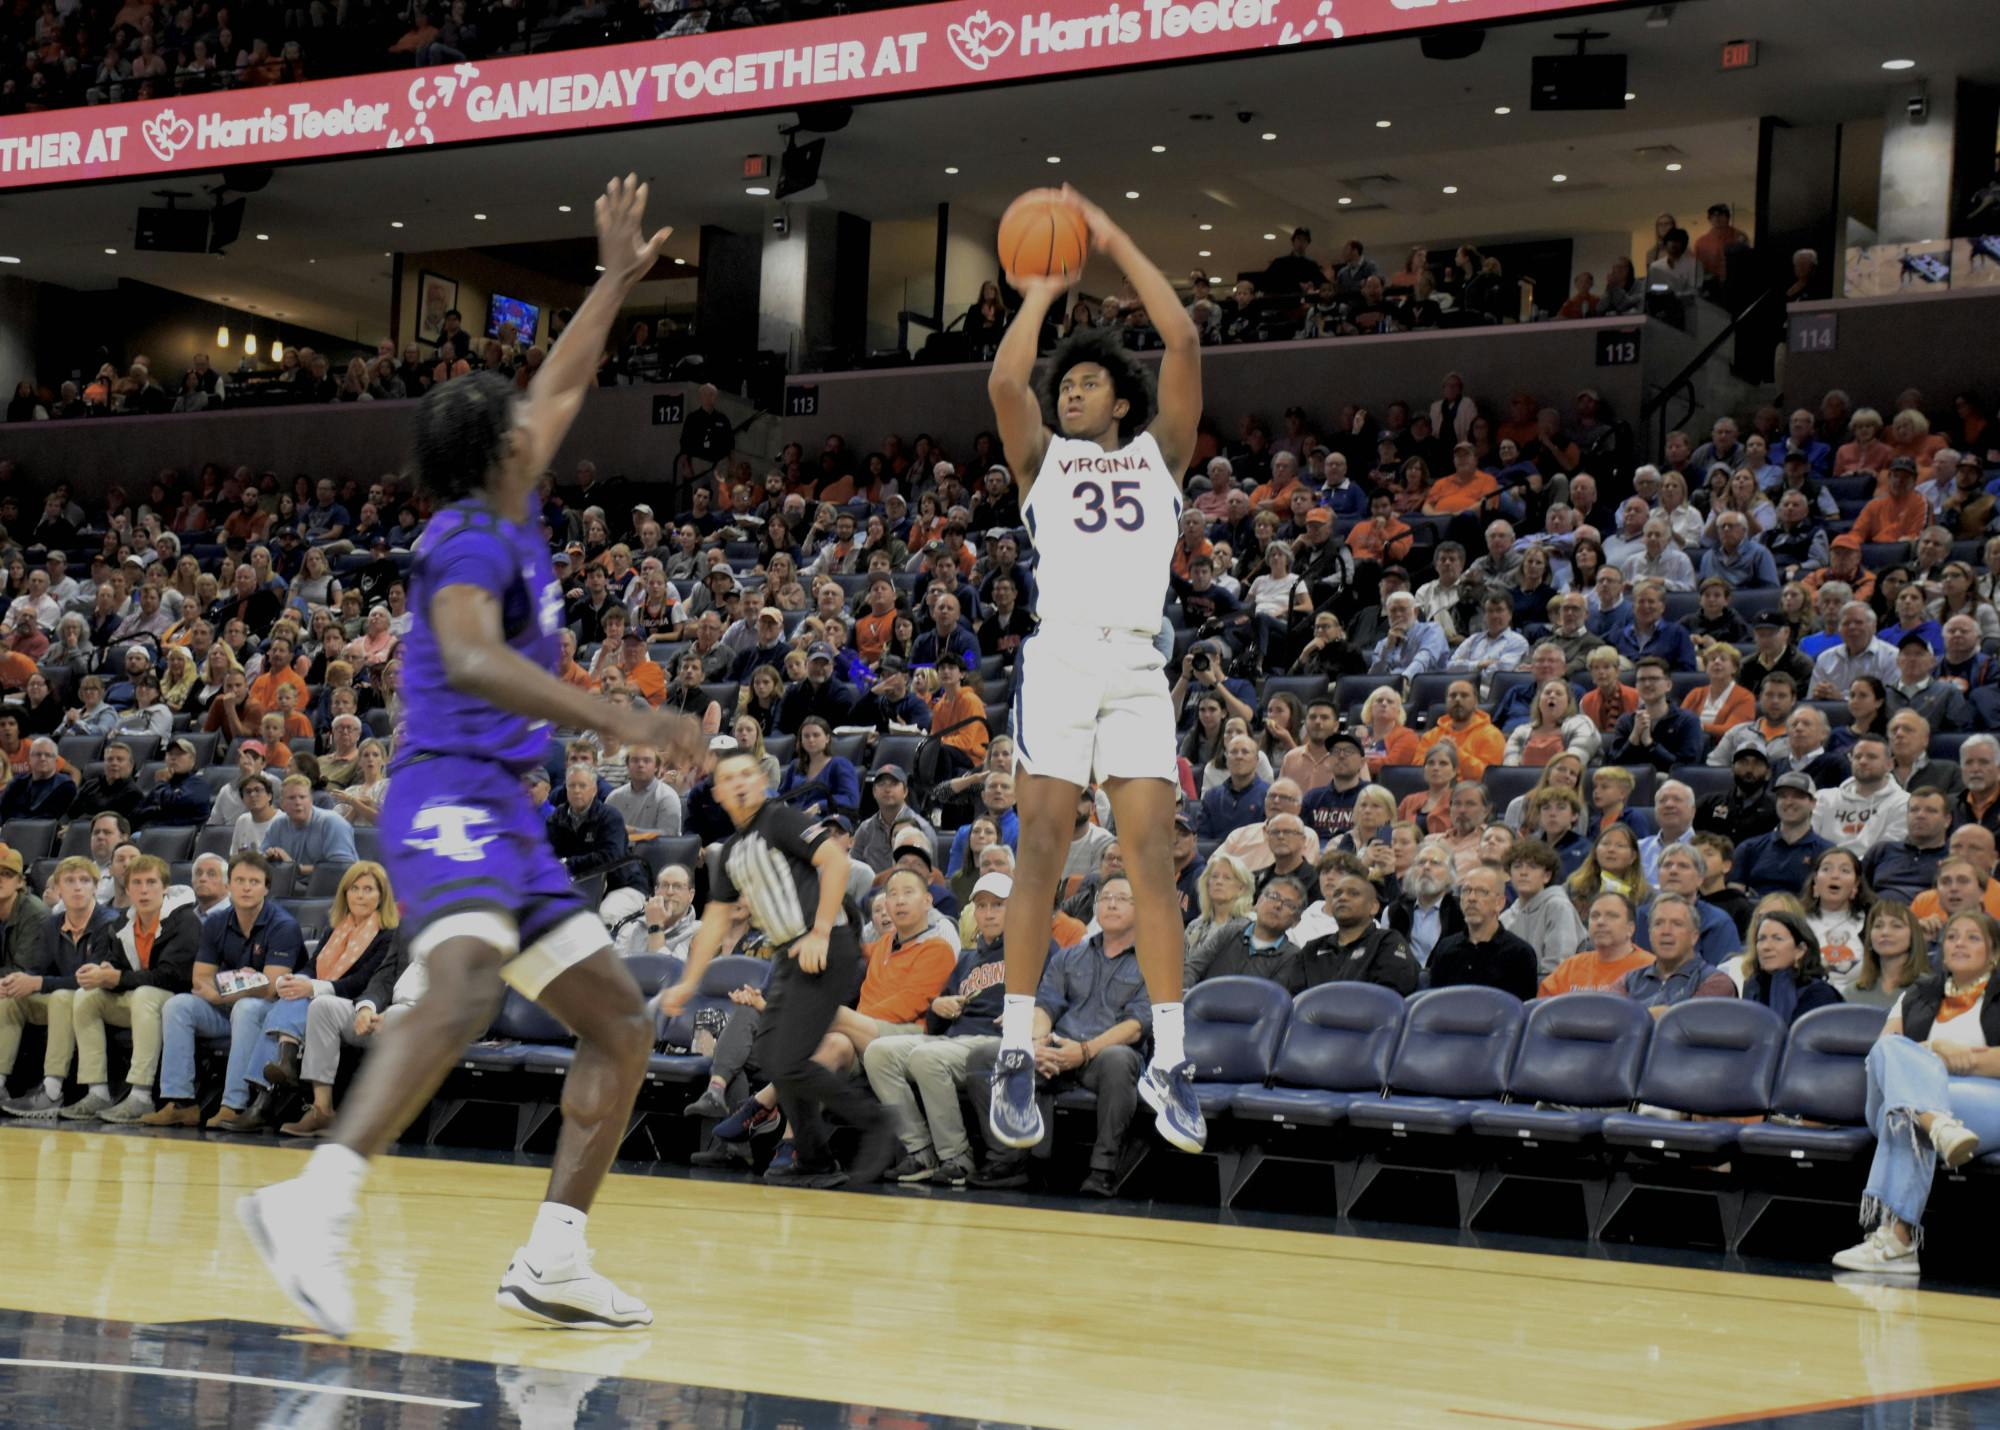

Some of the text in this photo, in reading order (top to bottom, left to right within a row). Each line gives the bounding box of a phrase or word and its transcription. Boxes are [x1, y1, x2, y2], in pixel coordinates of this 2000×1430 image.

[1020, 2, 1141, 56] Harris
[1723, 46, 1748, 67] EXIT
[467, 32, 927, 121] GAMEDAY TOGETHER AT
[196, 98, 388, 150] Harris Teeter
[0, 126, 128, 171] THER AT
[1799, 328, 1831, 349] 114
[1605, 342, 1635, 363] 113
[658, 405, 680, 423] 112
[793, 396, 815, 414] 113
[1058, 456, 1151, 475] VIRGINIA
[1072, 481, 1145, 533] 35
[1312, 808, 1354, 823] VIRGIN
